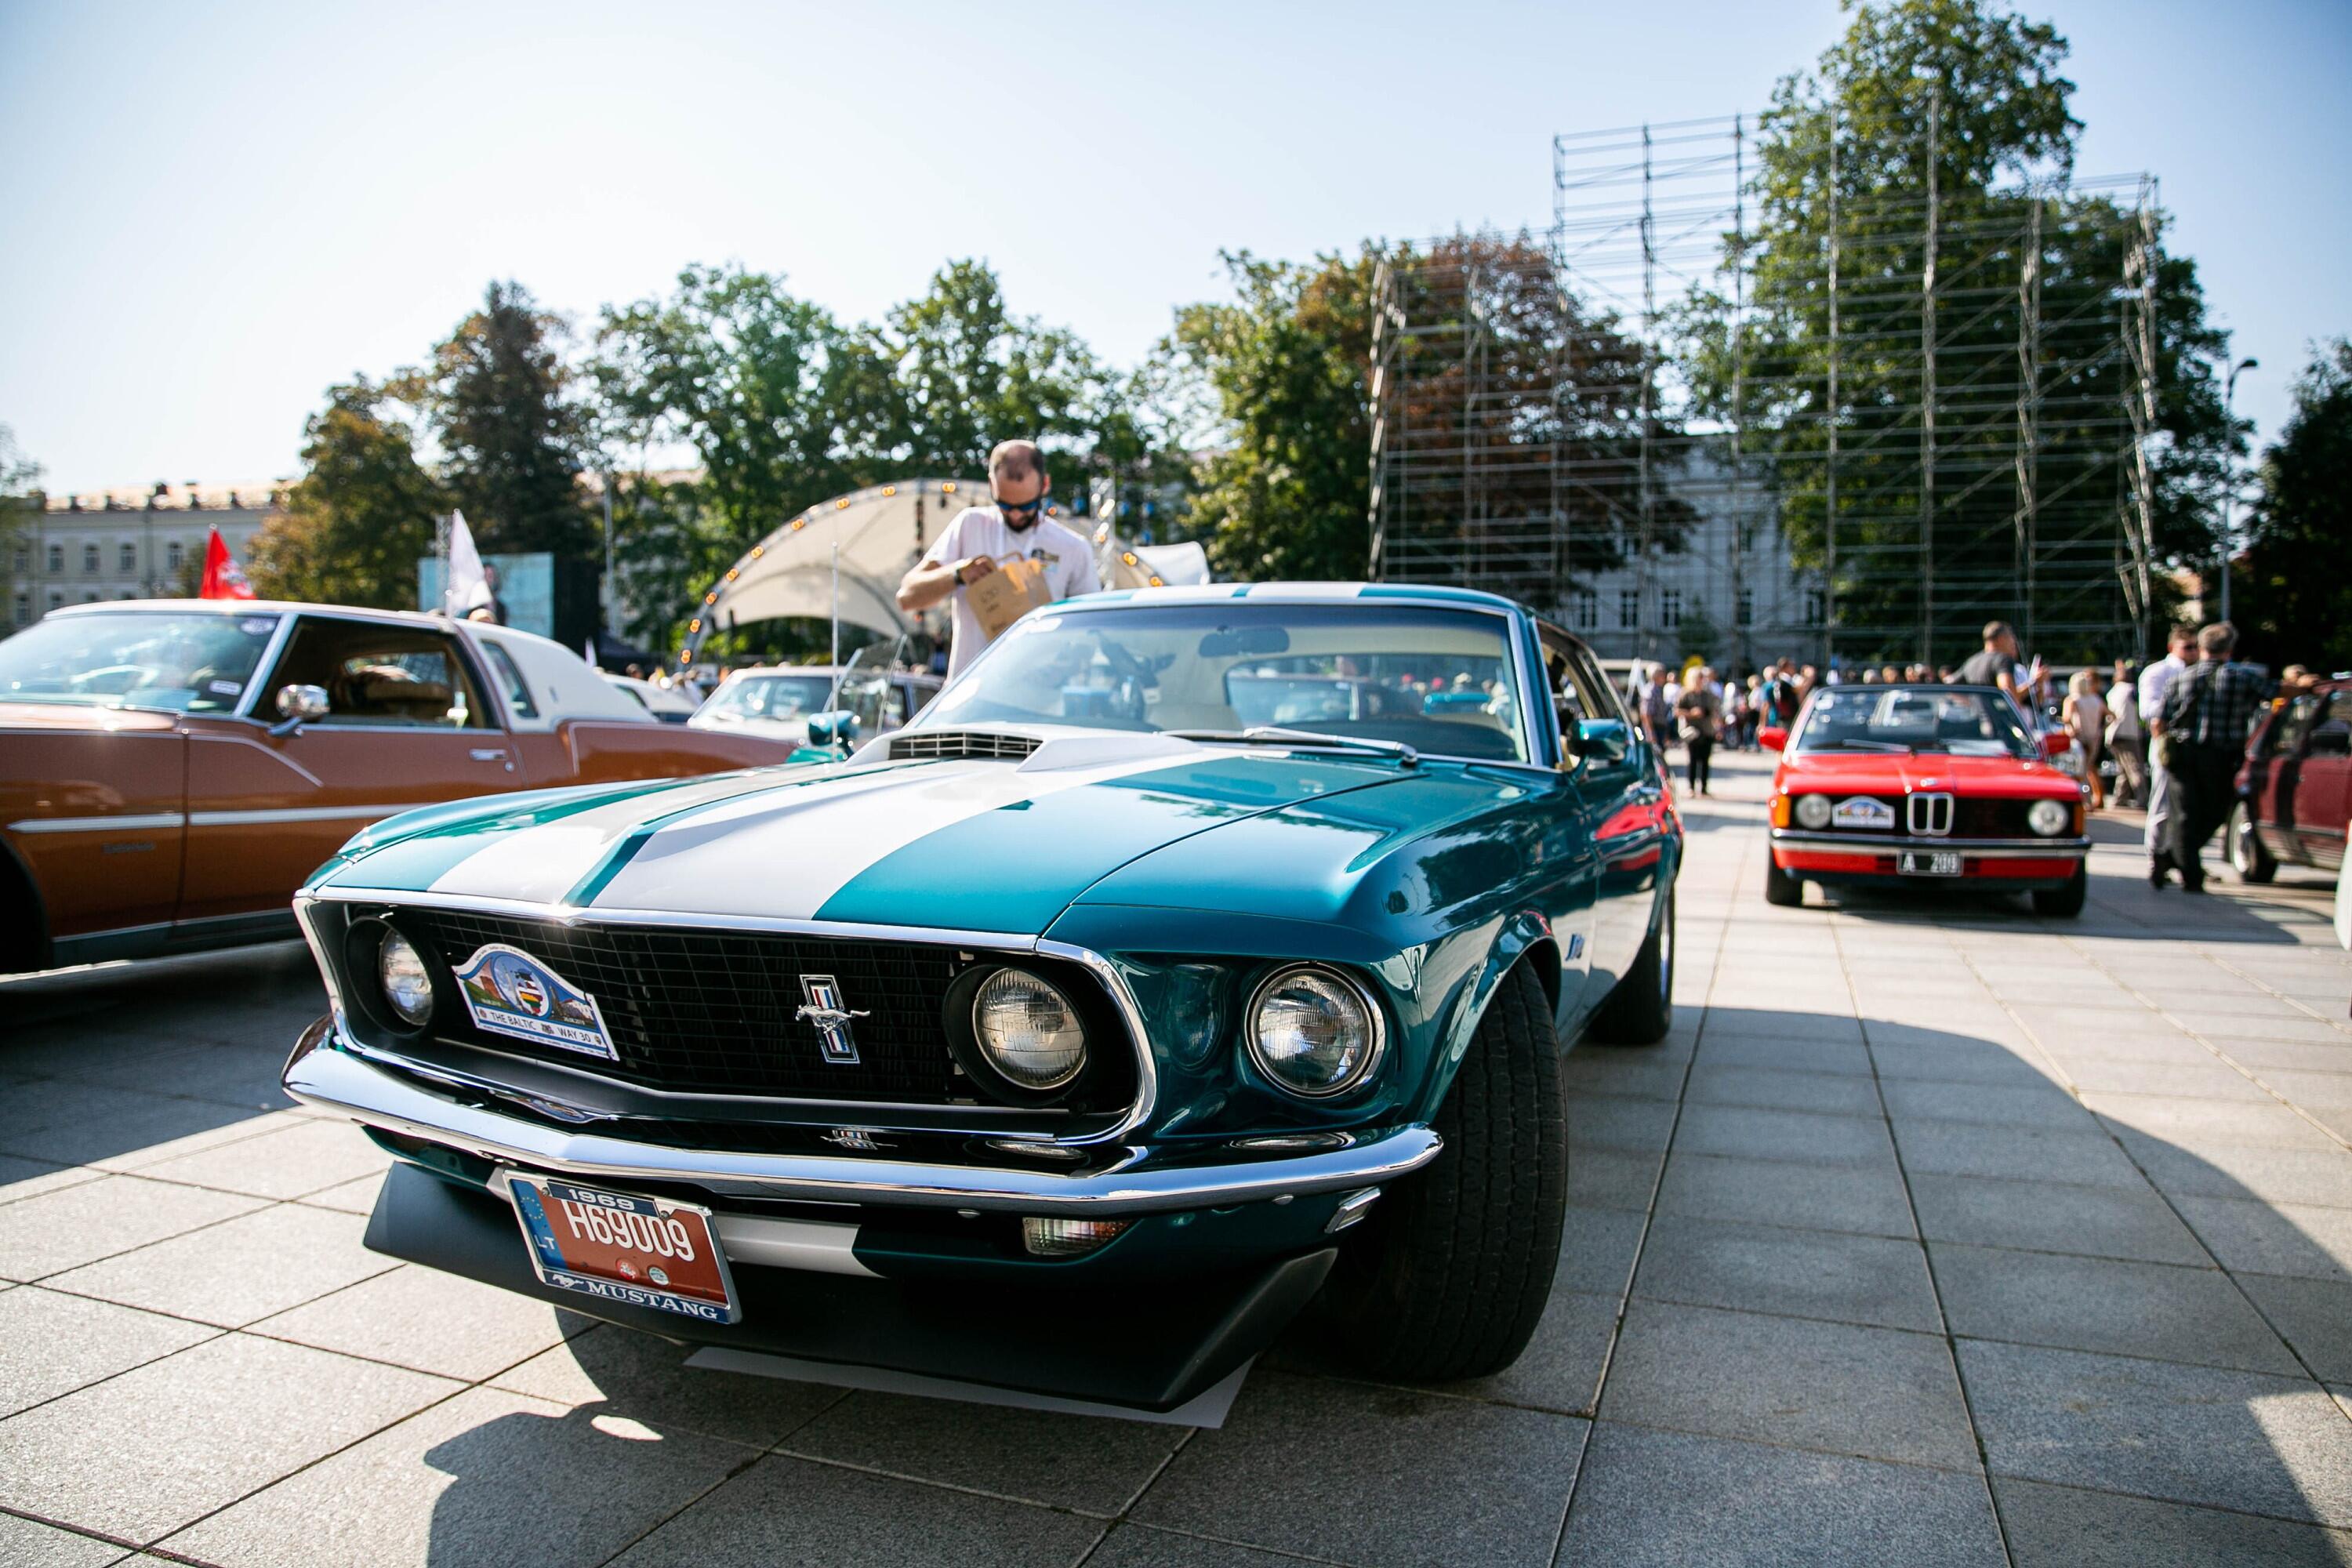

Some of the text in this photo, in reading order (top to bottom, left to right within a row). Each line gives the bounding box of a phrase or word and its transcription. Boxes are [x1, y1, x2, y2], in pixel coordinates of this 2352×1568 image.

[491, 1012, 508, 1025] THE
[509, 1014, 537, 1031] BALTIC
[557, 1026, 579, 1040] WAY
[579, 1032, 591, 1044] 30
[568, 1188, 635, 1212] 1969
[535, 1234, 556, 1250] LT
[561, 1198, 695, 1263] H69009
[587, 1279, 718, 1321] MUSTANG
